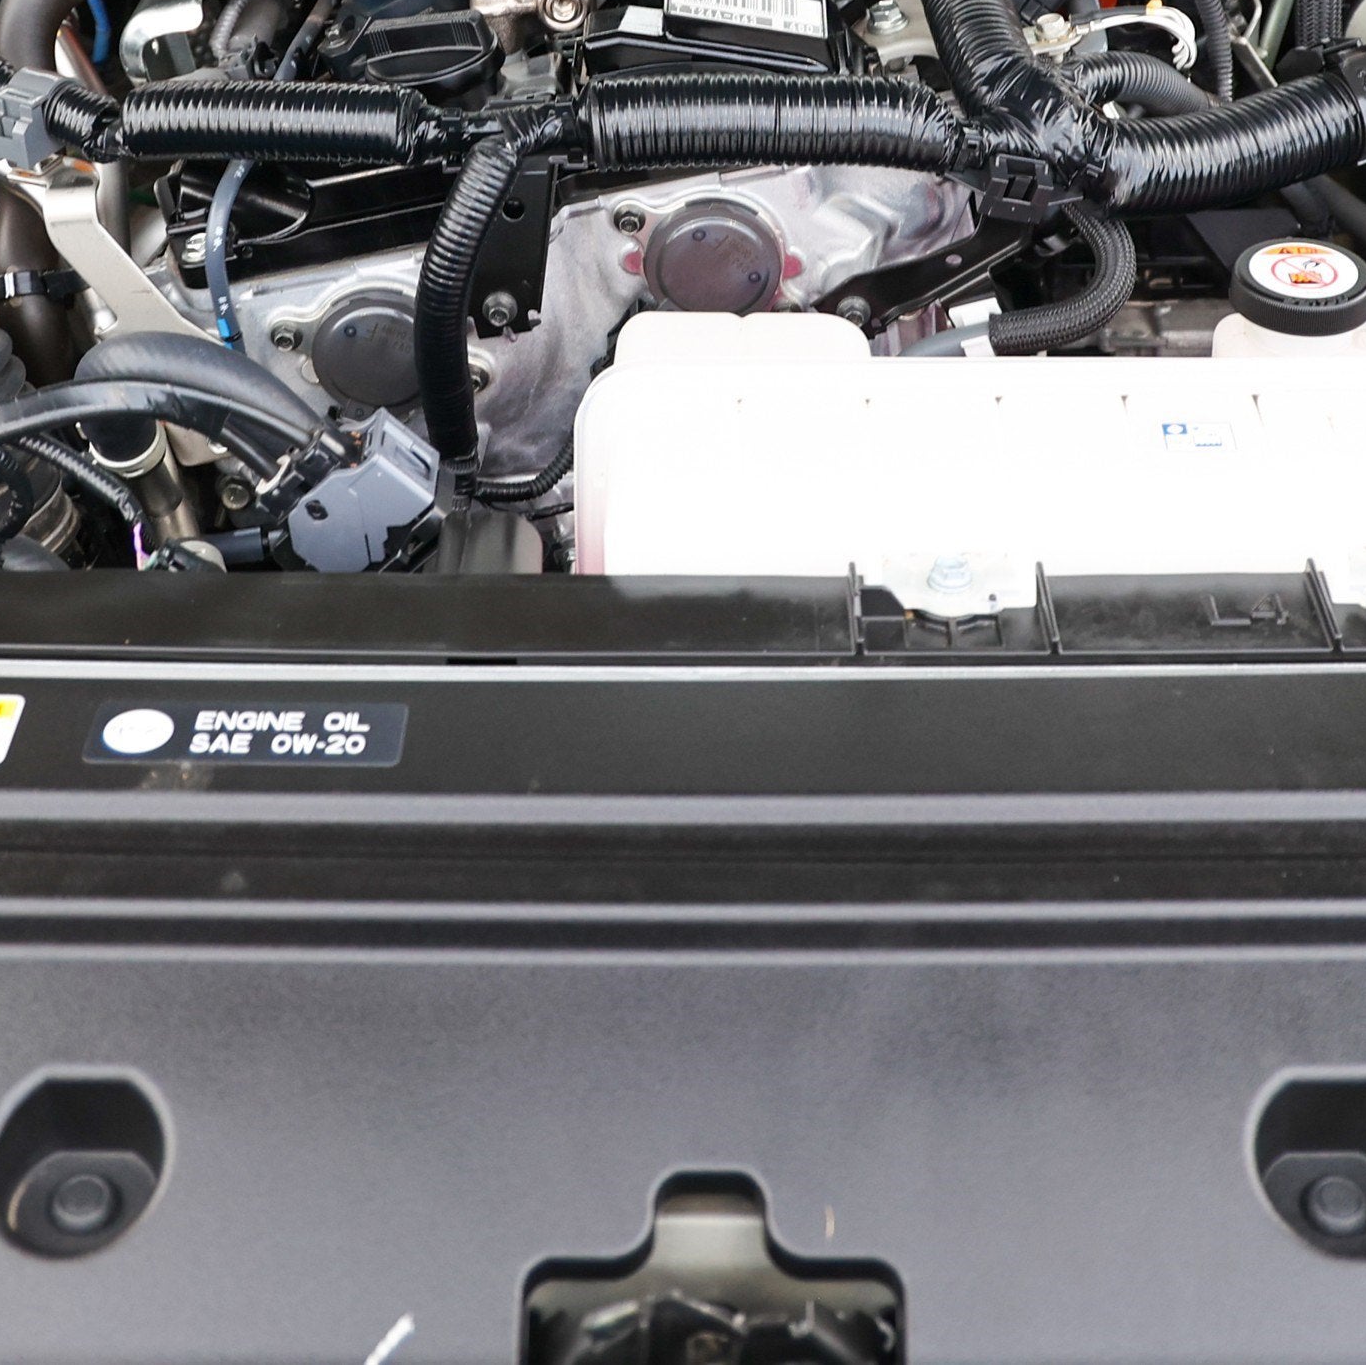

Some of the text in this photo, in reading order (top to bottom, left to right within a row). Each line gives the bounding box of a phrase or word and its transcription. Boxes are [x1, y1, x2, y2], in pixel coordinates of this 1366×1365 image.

[193, 709, 372, 732] ENGINE OIL
[188, 733, 367, 755] SAE 0W-20
